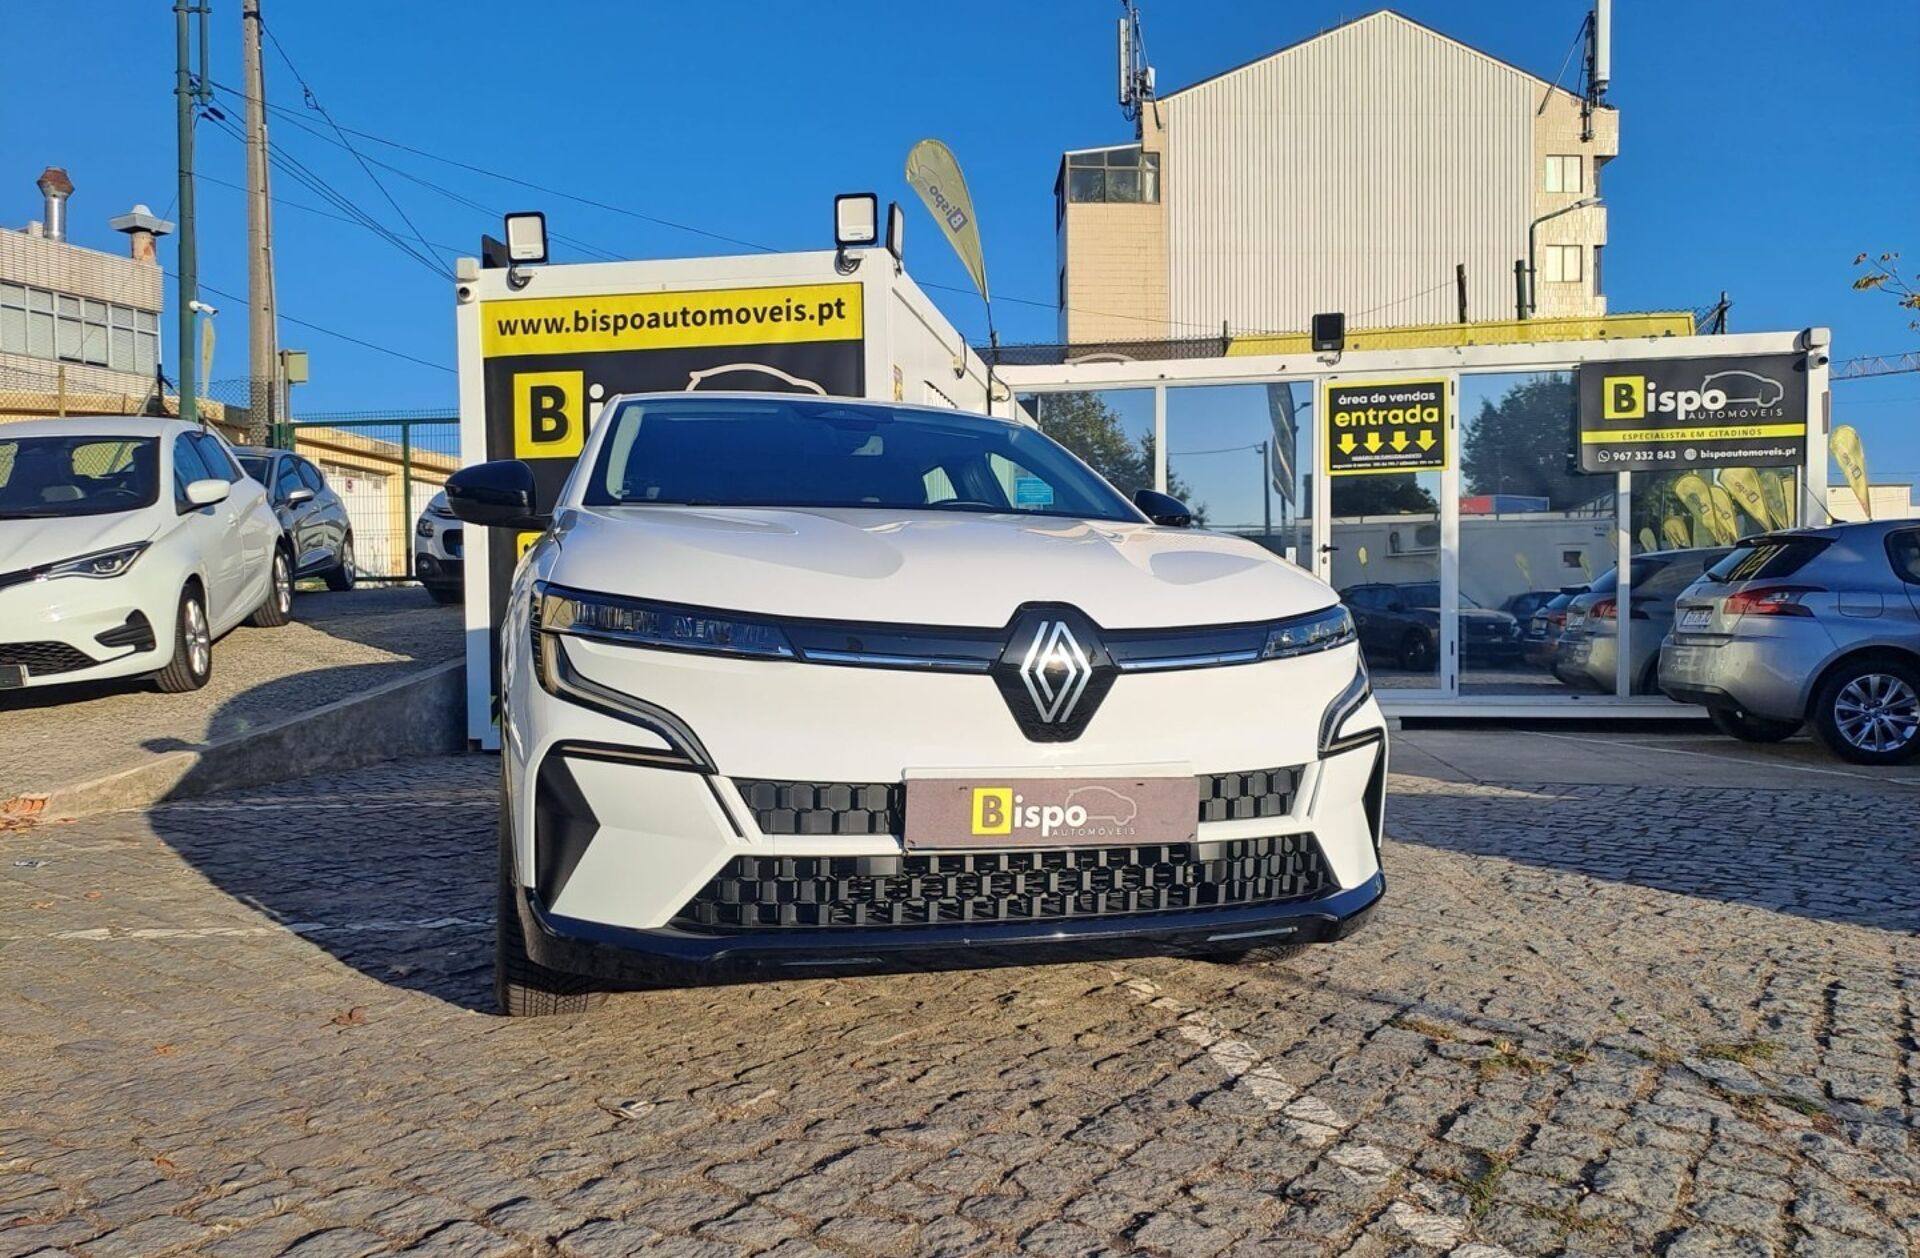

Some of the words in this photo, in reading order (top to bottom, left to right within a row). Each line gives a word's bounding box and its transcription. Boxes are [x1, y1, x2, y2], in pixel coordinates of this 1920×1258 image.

[497, 298, 846, 336] www.bispoautomoveis.pt
[1338, 394, 1368, 405] área
[1370, 393, 1387, 403] de
[1389, 391, 1436, 402] vendas
[1613, 382, 1727, 420] Bispo
[1335, 404, 1439, 427] entrada
[1688, 408, 1784, 420] AUTOMÓVEIS
[1622, 431, 1687, 441] ESPECIALISTA
[1690, 430, 1705, 438] EM
[1709, 428, 1763, 438] CITADINOS
[1612, 453, 1632, 462] 967
[1634, 452, 1654, 461] 332
[1657, 450, 1676, 460] 843
[1700, 447, 1796, 460] bispoautomoveis.pt
[982, 794, 1087, 837] Bispo
[1051, 827, 1136, 837] AUTOMÓVEIS
